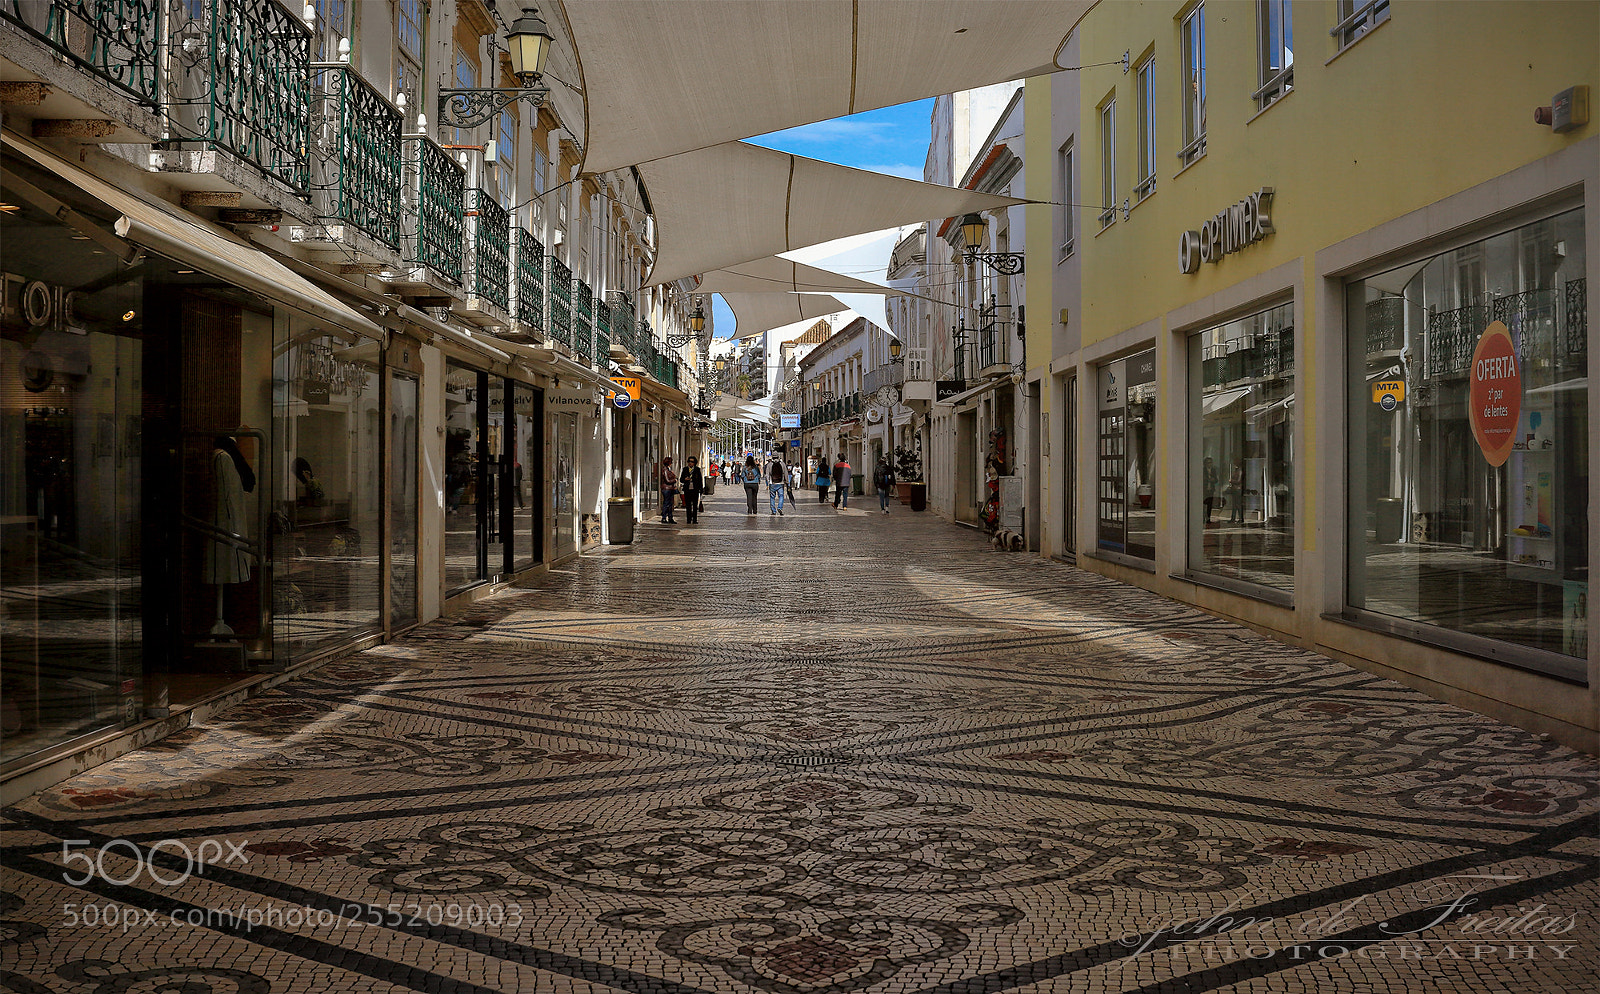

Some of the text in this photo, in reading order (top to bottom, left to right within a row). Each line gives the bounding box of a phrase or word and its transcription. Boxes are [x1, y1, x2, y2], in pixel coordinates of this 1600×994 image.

[1200, 187, 1276, 263] OPTIMAX
[1476, 355, 1516, 382] OFERTA
[548, 396, 592, 406] Vilanova
[1494, 389, 1503, 404] par
[1483, 404, 1508, 418] de lentes
